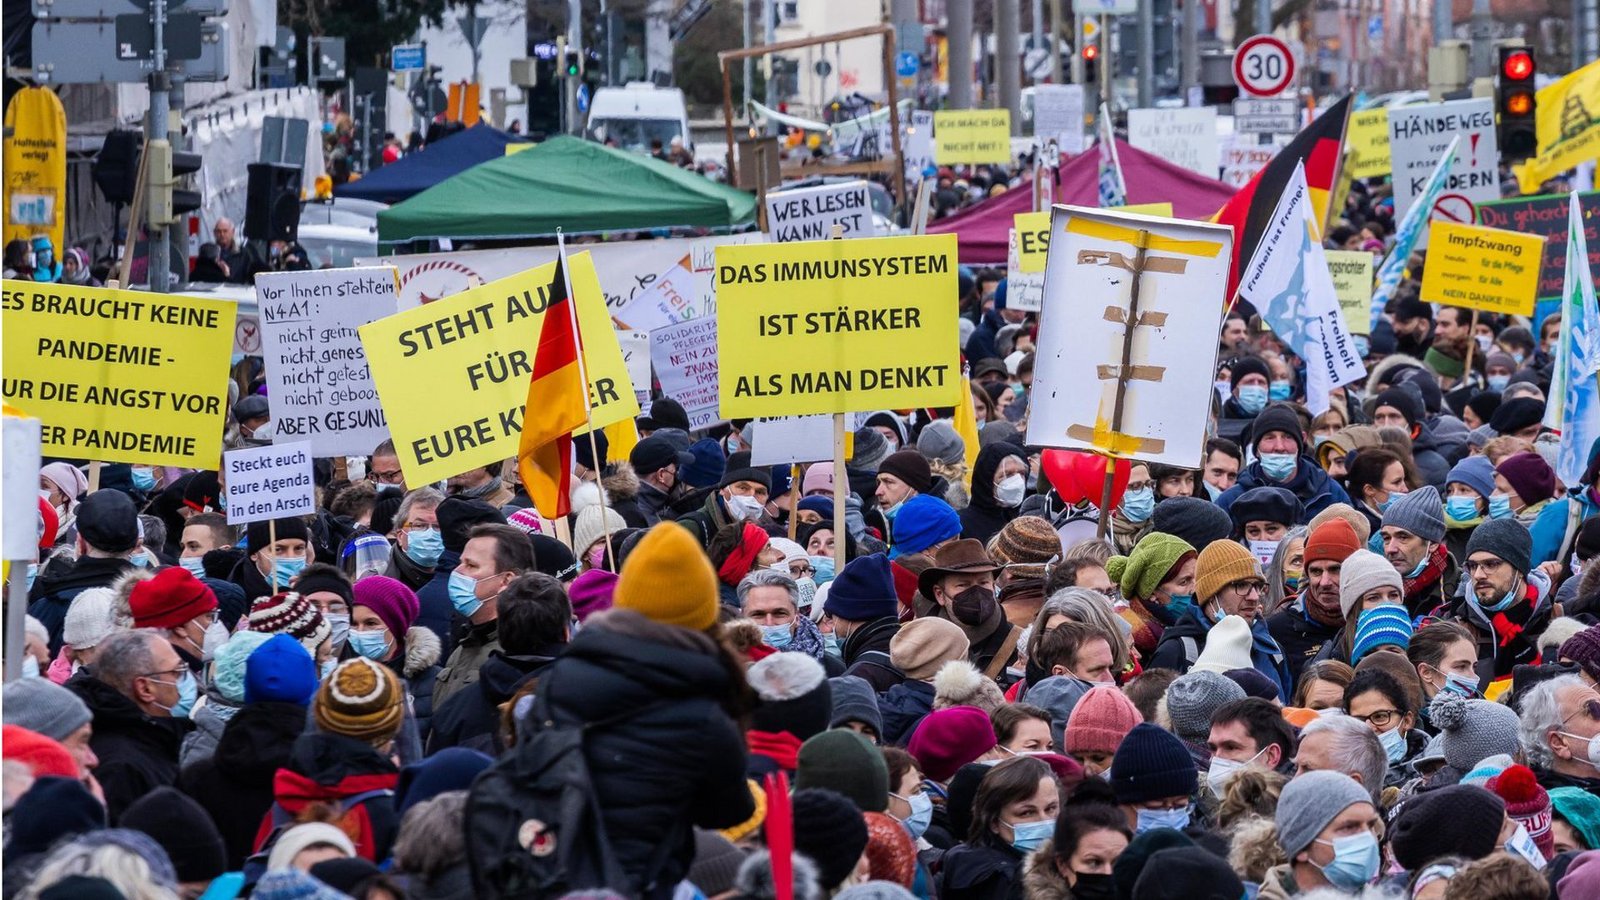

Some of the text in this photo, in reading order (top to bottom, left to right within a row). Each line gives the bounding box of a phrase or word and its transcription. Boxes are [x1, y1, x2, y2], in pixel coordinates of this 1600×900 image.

[1247, 54, 1281, 80] 30
[991, 117, 1007, 127] DA
[1393, 112, 1492, 139] HÄNDE WEG
[1407, 156, 1461, 169] unsen
[1410, 170, 1493, 196] KDERN
[772, 188, 865, 222] WER LESEN
[1480, 205, 1508, 227] Du
[1021, 230, 1050, 254] ES
[1247, 184, 1305, 292] Freiheit ist Freihei
[1448, 233, 1523, 257] Impfzwang
[720, 254, 948, 284] DAS IMMUNSYSTEM
[262, 287, 286, 300] Vor
[291, 282, 332, 298] Ihnen
[1442, 288, 1467, 299] NEIN
[1468, 290, 1503, 305] DANKE
[2, 291, 220, 329] ES BRAUCHT KEINE
[759, 305, 922, 337] IST STÄRKER
[279, 322, 363, 344] nicht geim
[398, 303, 495, 358] STEHT
[1327, 310, 1356, 370] Freiheit
[37, 337, 162, 367] PANDEMIE
[280, 345, 365, 365] nicht genes
[283, 363, 369, 386] nicht getest
[466, 351, 533, 392] FÜR
[685, 359, 718, 377] ZWAN
[734, 365, 948, 398] ALS MAN DENKT
[2, 378, 220, 415] UR DIE ANGST VOR
[285, 385, 324, 406] nicht
[275, 415, 321, 435] ABER
[411, 377, 620, 466] EURE KIER
[41, 425, 197, 456] ER PANDEMIE
[231, 450, 306, 473] Steckt euch
[230, 472, 310, 495] eure Agenda
[231, 494, 311, 517] in den Arsch
